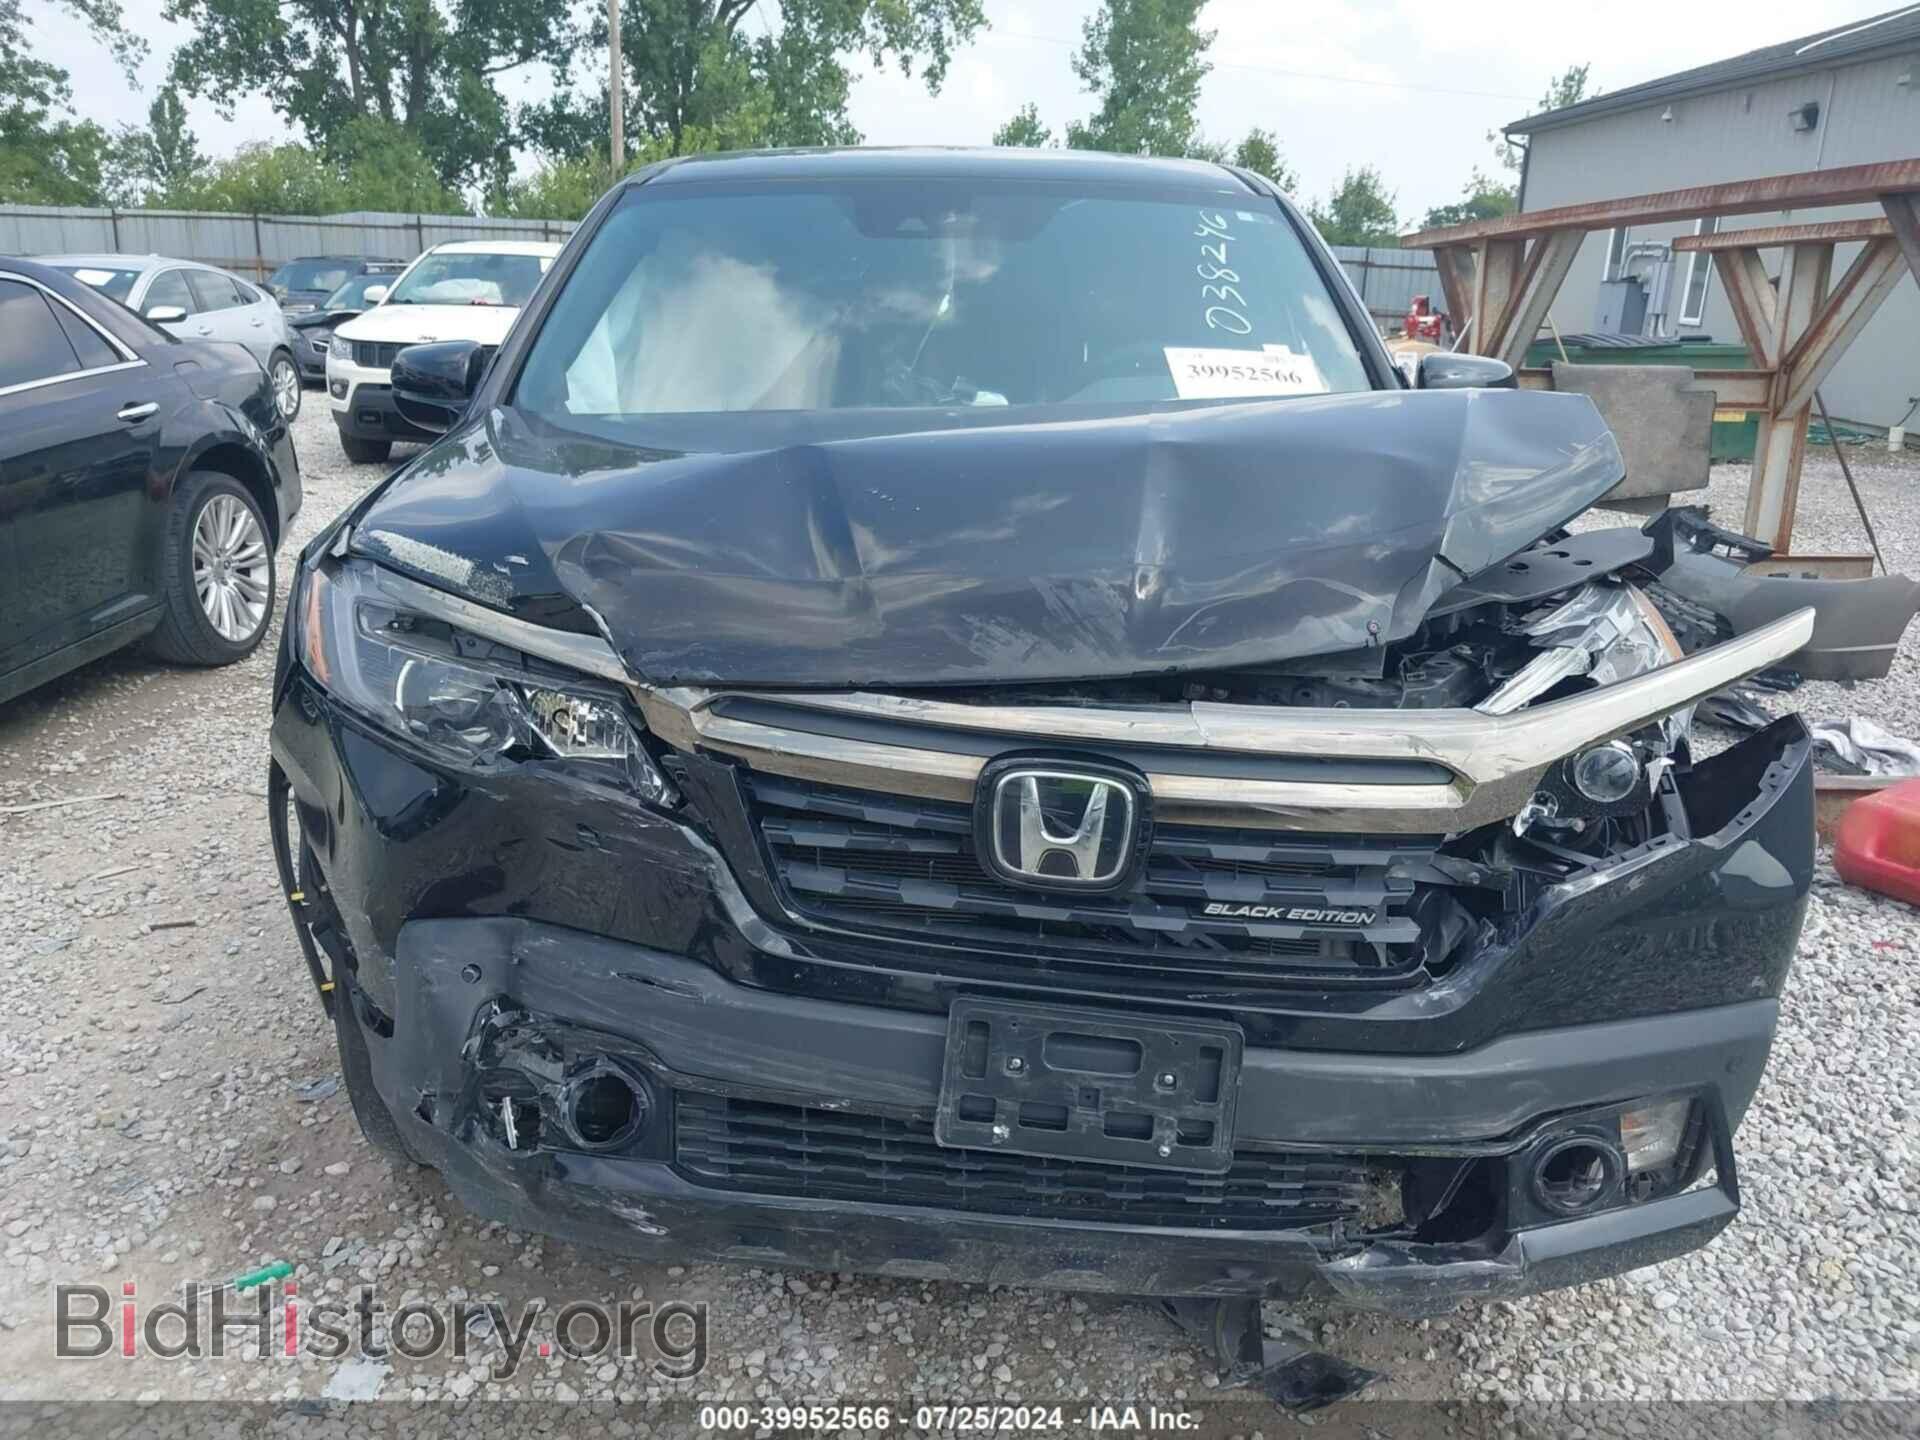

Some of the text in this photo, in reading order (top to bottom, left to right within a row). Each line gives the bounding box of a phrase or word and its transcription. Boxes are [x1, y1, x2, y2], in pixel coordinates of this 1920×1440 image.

[1193, 210, 1252, 335] 038246
[1187, 364, 1302, 383] 39952566
[1204, 903, 1376, 924] BLACK EDITION
